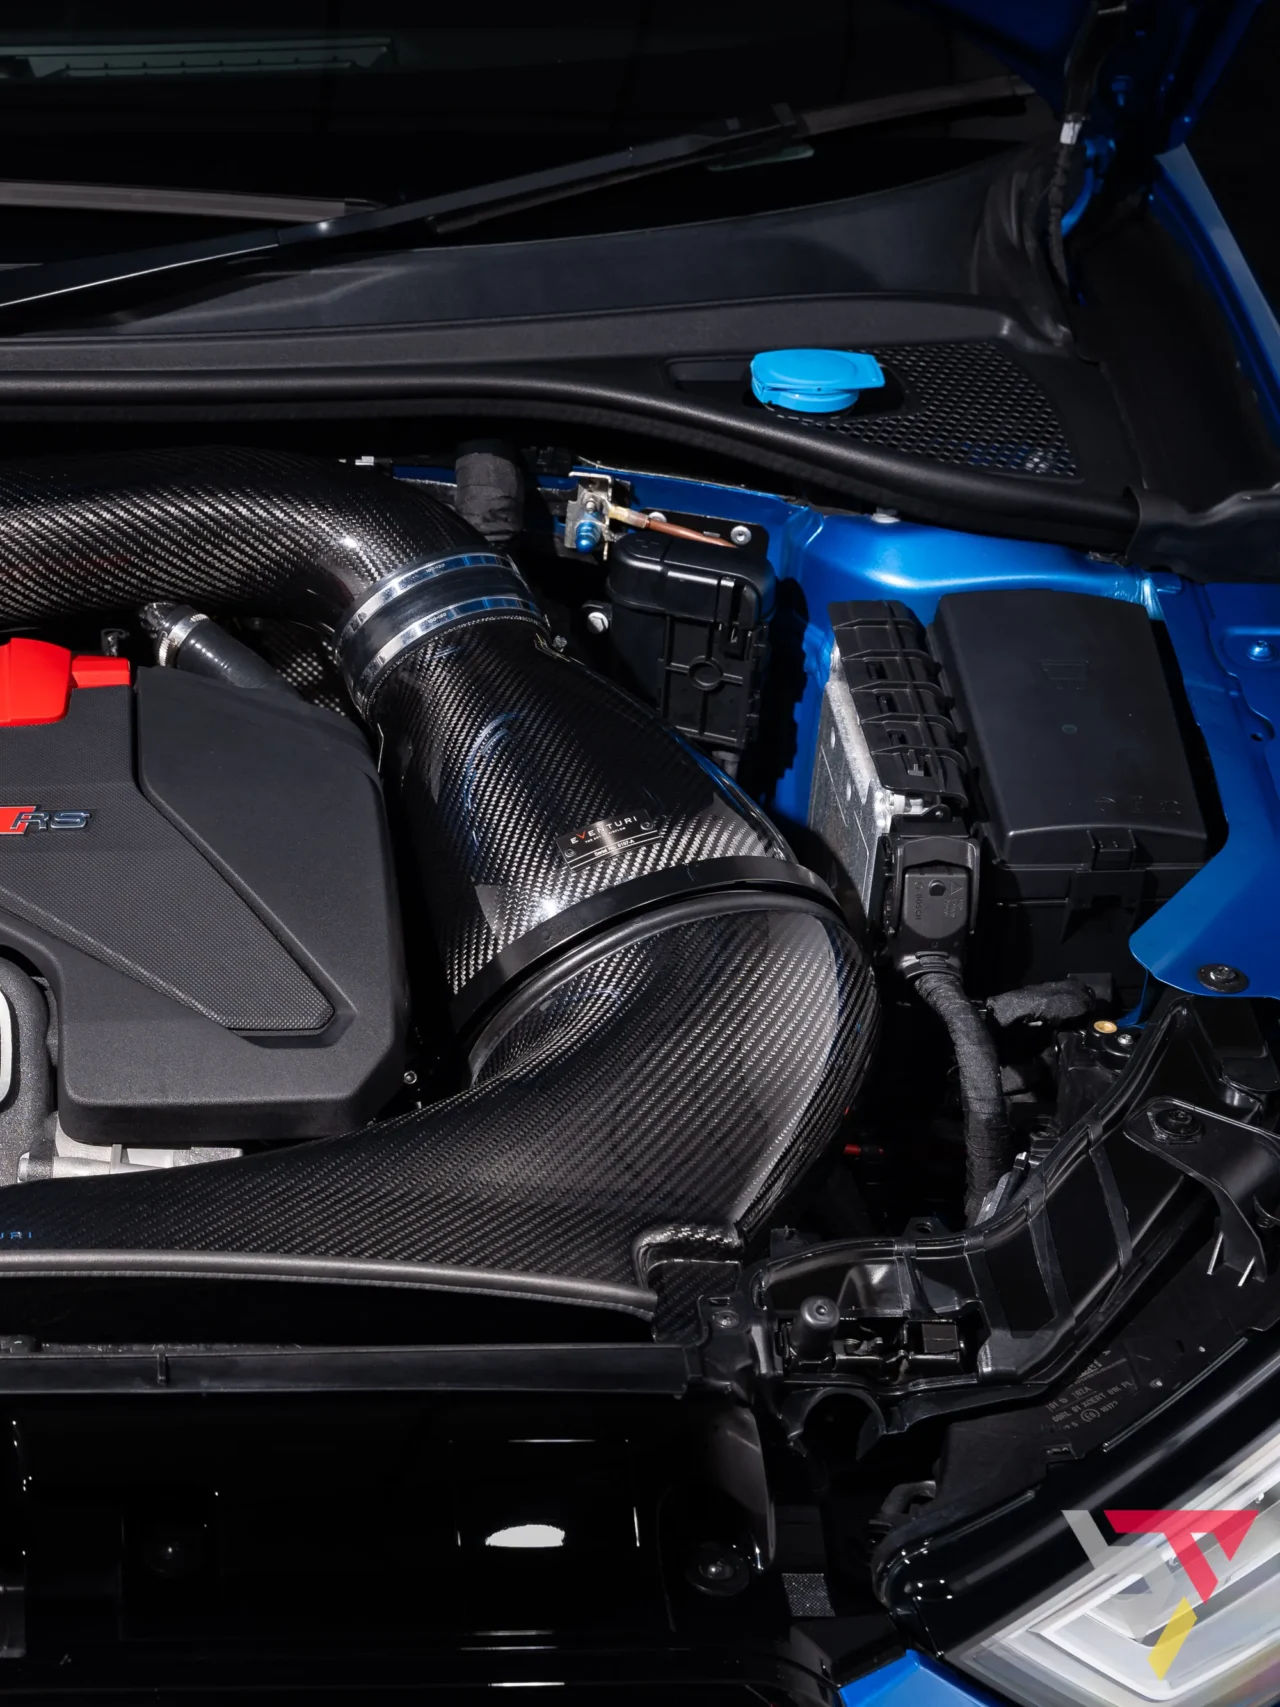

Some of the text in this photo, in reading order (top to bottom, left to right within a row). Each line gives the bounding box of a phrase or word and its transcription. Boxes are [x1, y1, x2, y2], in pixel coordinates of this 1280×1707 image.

[7, 809, 92, 831] RS
[570, 815, 638, 845] EVENTURI
[915, 893, 923, 921] BOSCH
